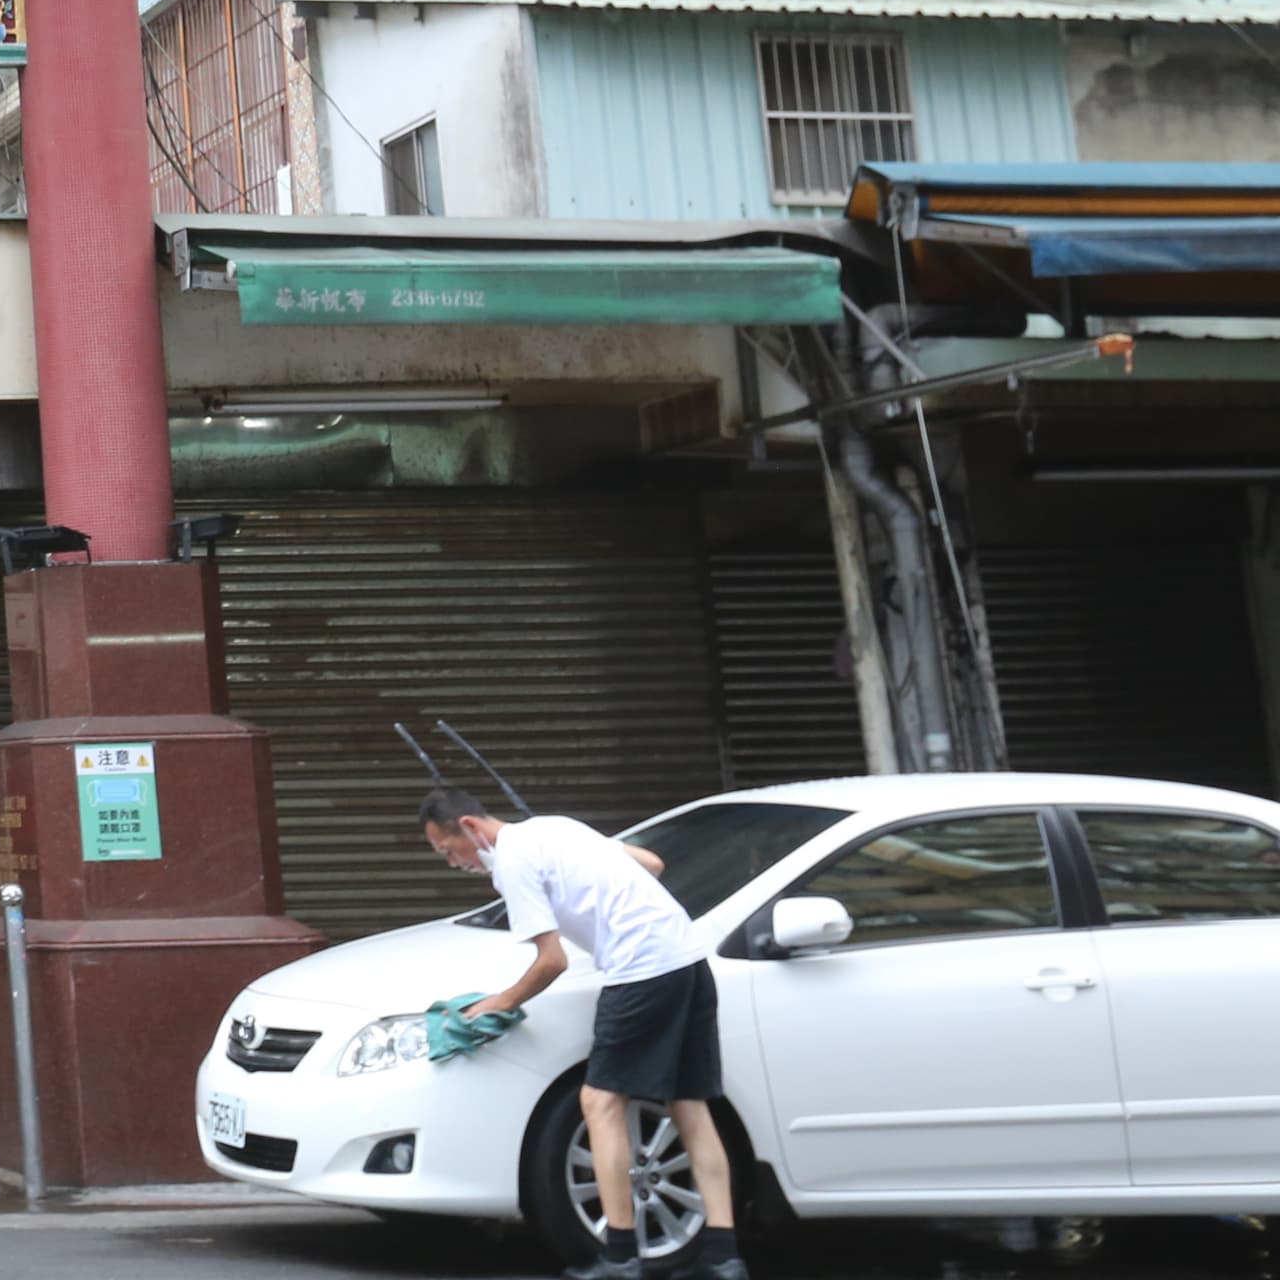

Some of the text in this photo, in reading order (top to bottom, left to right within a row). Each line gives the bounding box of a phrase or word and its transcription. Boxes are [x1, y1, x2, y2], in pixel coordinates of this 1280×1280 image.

[98, 750, 130, 766] 注意
[99, 822, 141, 834] 請戴口罩
